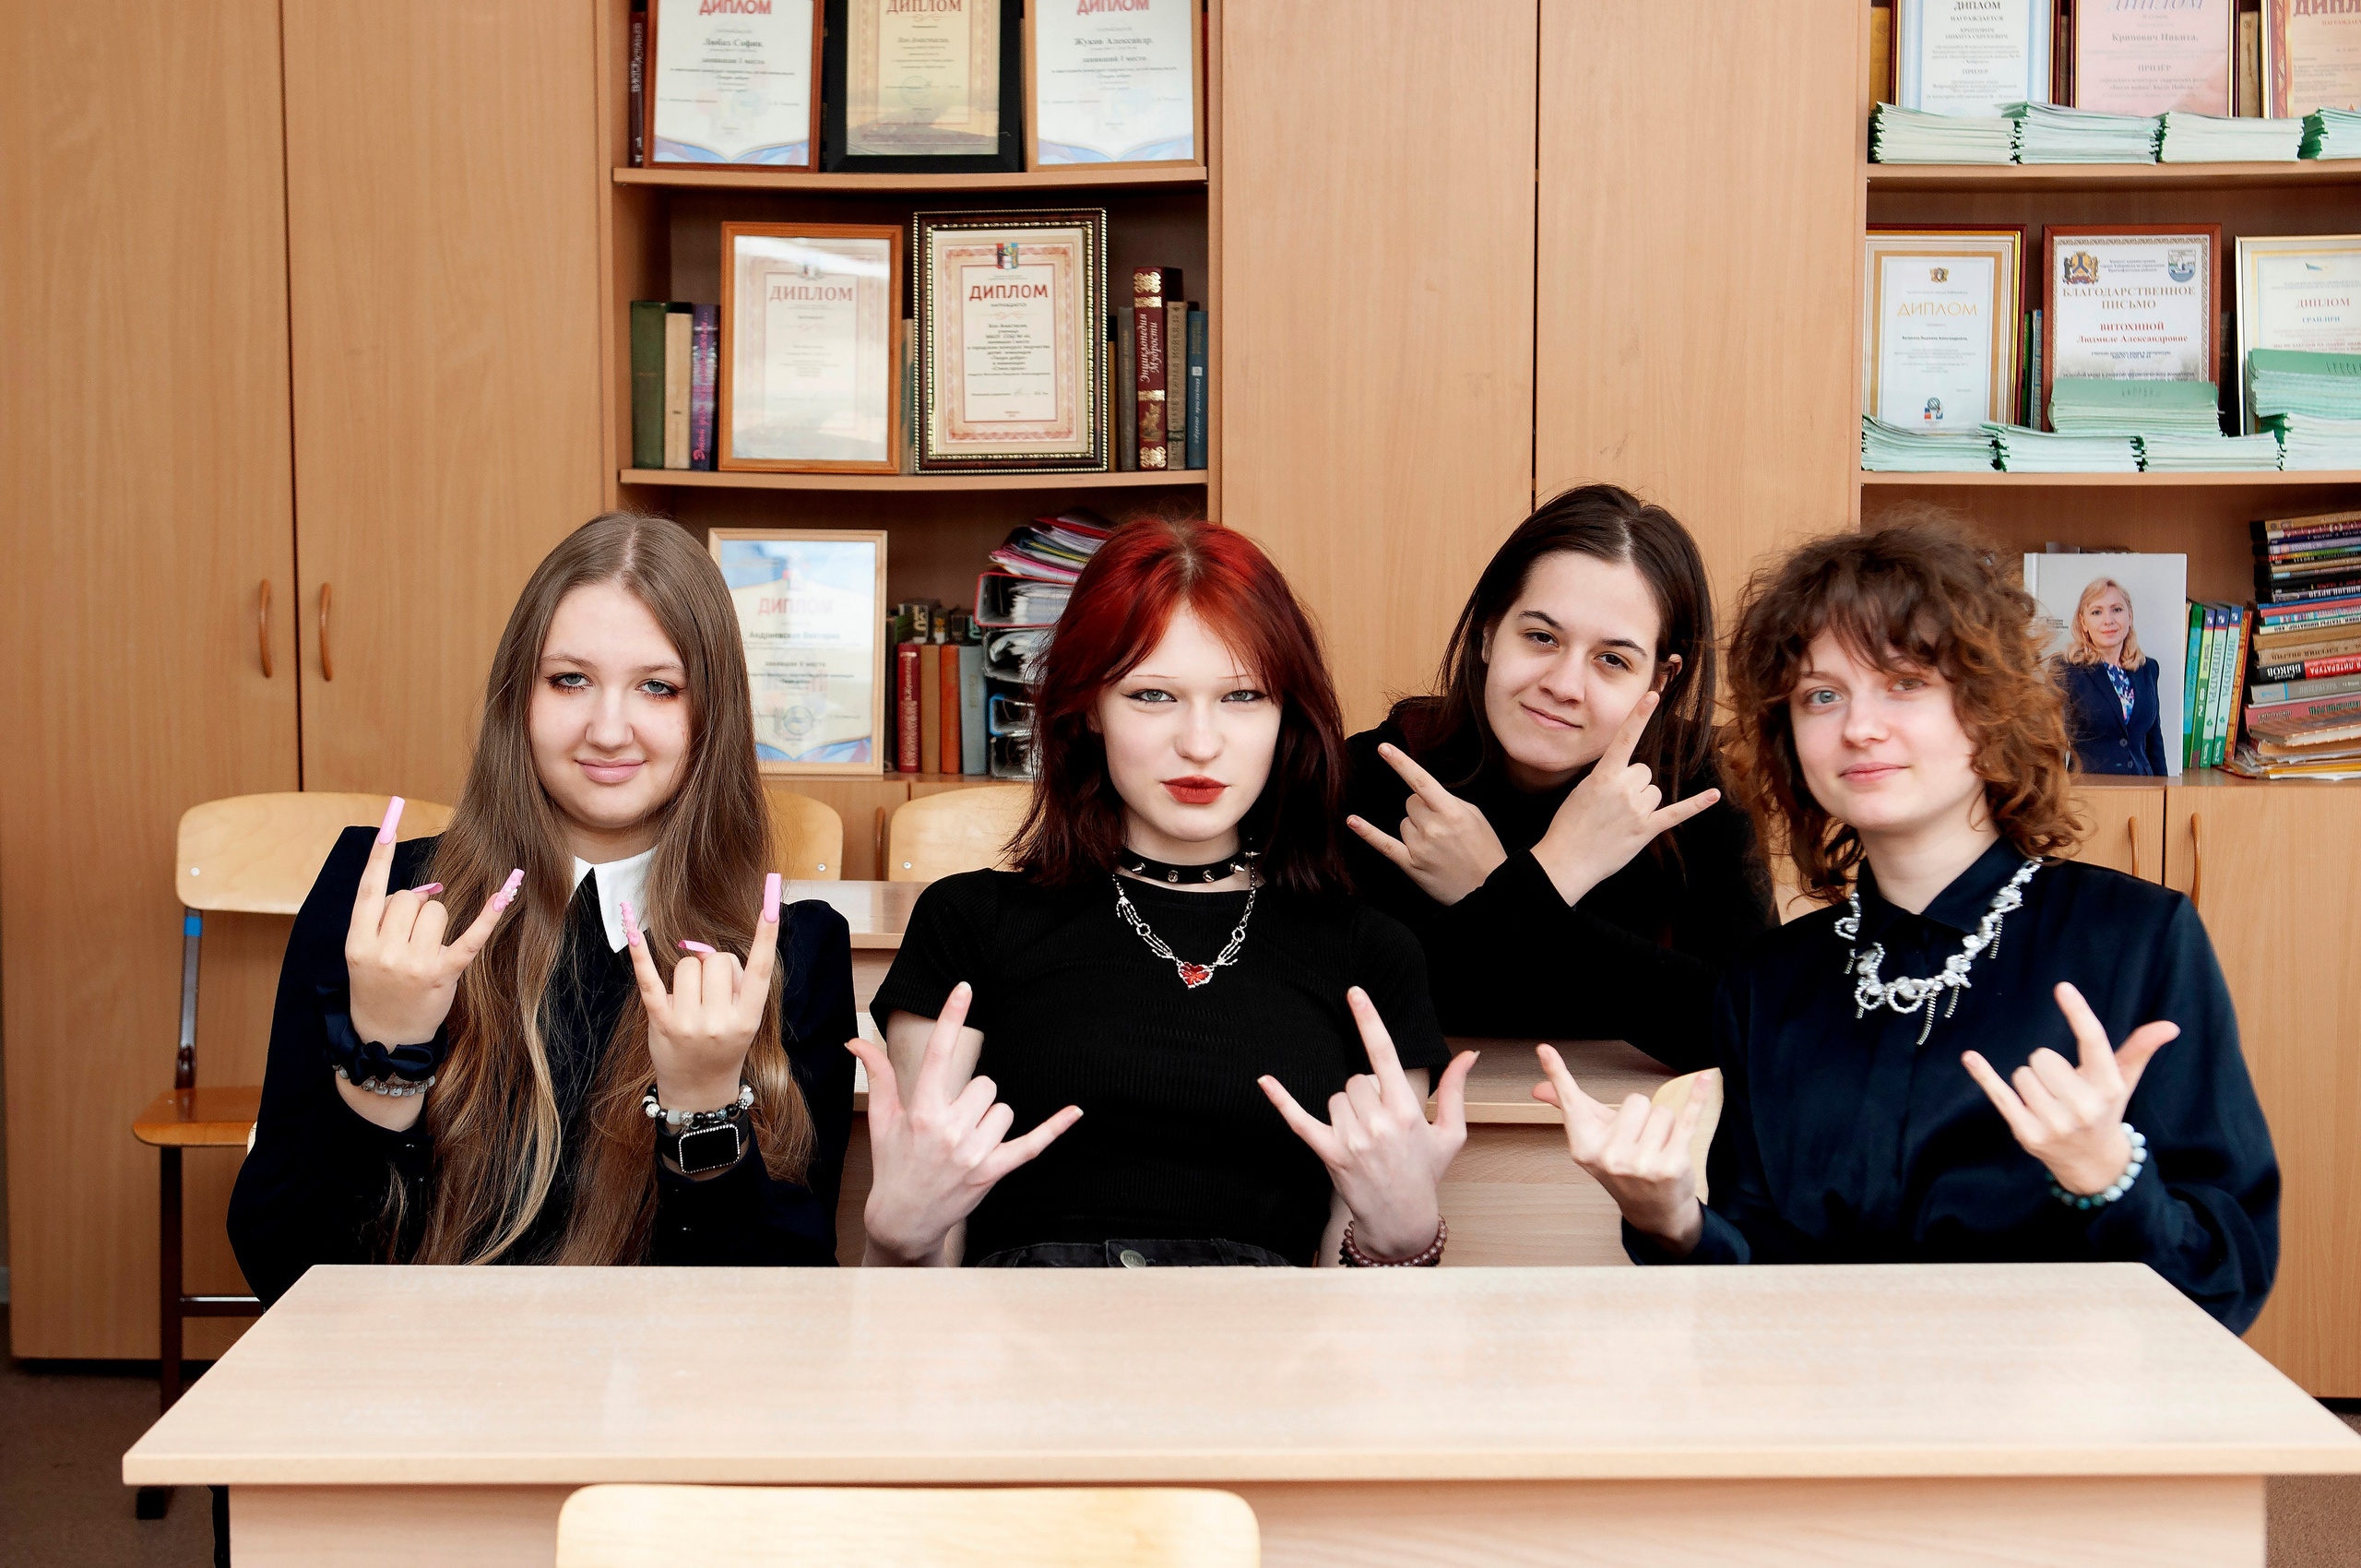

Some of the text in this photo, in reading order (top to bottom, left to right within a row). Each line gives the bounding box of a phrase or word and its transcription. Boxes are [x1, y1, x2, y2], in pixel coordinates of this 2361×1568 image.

[699, 0, 772, 15] ДИПЛОМ
[886, 0, 962, 15] ДИПЛОМ
[1076, 0, 1150, 15] ДИПЛОМ
[1953, 1, 2001, 11] ДИПЛОМ
[769, 286, 853, 302] ДИПЛОМ
[969, 284, 1049, 302] ДИПЛОМ
[2062, 286, 2196, 298] БЛАГОДАРСТВЕННОЕ
[1897, 302, 1977, 317] ДИПЛОМ
[2102, 300, 2156, 310] ПИСЬМО
[2296, 298, 2350, 309] ДИПЛОМ
[2100, 321, 2165, 332] ВИТОХИНОЙ
[2076, 335, 2189, 344] Людмиле Александровне
[1137, 313, 1150, 383] Энциклопедия
[1149, 322, 1162, 374] Мудрости
[758, 598, 833, 616] ДИПЛОМ
[2208, 639, 2223, 704] ЛИТЕРАТУРА
[2222, 636, 2236, 697] ЛИТЕРАТУРА
[2267, 663, 2302, 678] БЫКОВ
[2310, 662, 2354, 676] ЛИТЕРАТУРА
